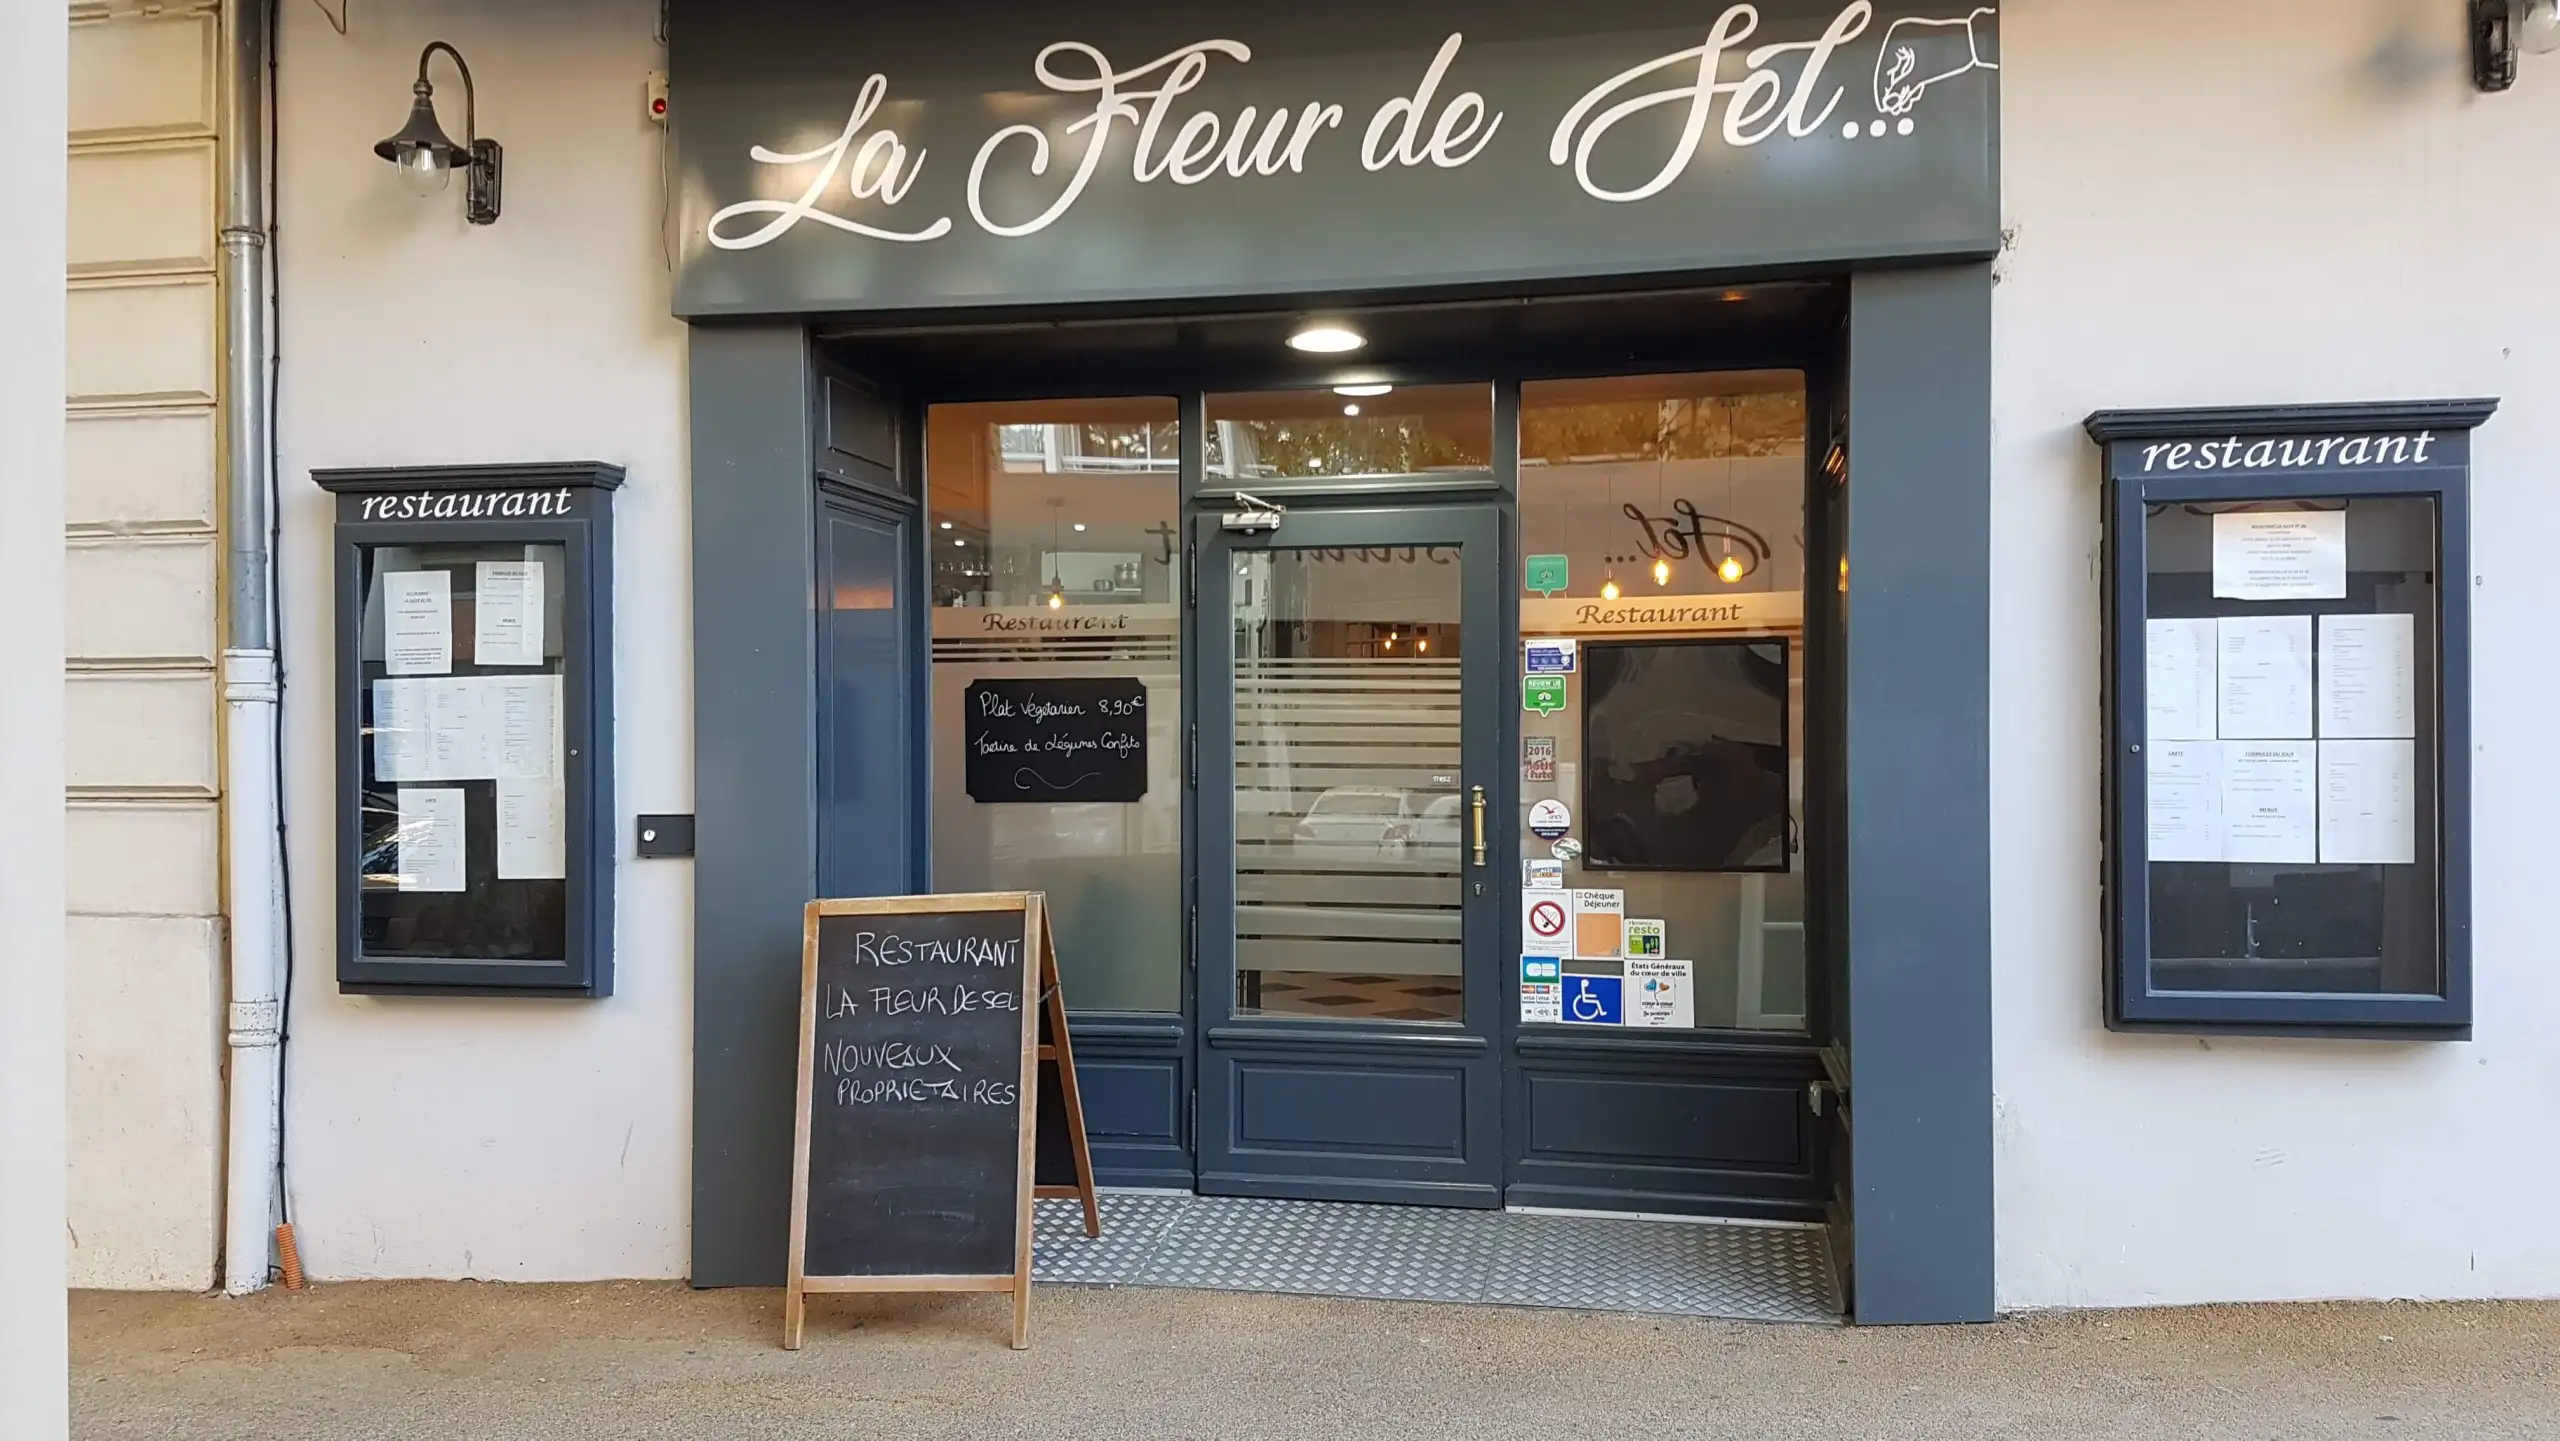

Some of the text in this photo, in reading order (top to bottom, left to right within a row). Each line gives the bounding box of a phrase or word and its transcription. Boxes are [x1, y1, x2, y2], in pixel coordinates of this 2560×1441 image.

[707, 73, 951, 250] La
[967, 39, 1343, 237] Fleur
[1361, 32, 1502, 171] de
[2142, 430, 2436, 472] restaurant
[361, 487, 573, 520] restaurant
[983, 612, 1130, 631] Restaurant
[1575, 603, 1744, 625] Restaurant
[980, 691, 1016, 718] Plat
[1098, 695, 1145, 716] 8,90€
[1024, 739, 1041, 752] de
[1044, 732, 1098, 758] Légumes
[1100, 731, 1140, 760] Confits
[1528, 746, 1552, 756] 2016
[1584, 892, 1615, 900] Chèque
[1584, 900, 1620, 909] Déjeuner
[1628, 926, 1660, 934] resto
[855, 932, 1021, 967] RESTAURANT
[1631, 962, 1685, 970] États Généraux
[826, 983, 859, 1019] LA
[868, 987, 947, 1015] FLEUR
[981, 991, 1019, 1012] SEL
[824, 1038, 962, 1076] NOUVEAUX
[837, 1077, 1017, 1106] PROPRIETAIRES
